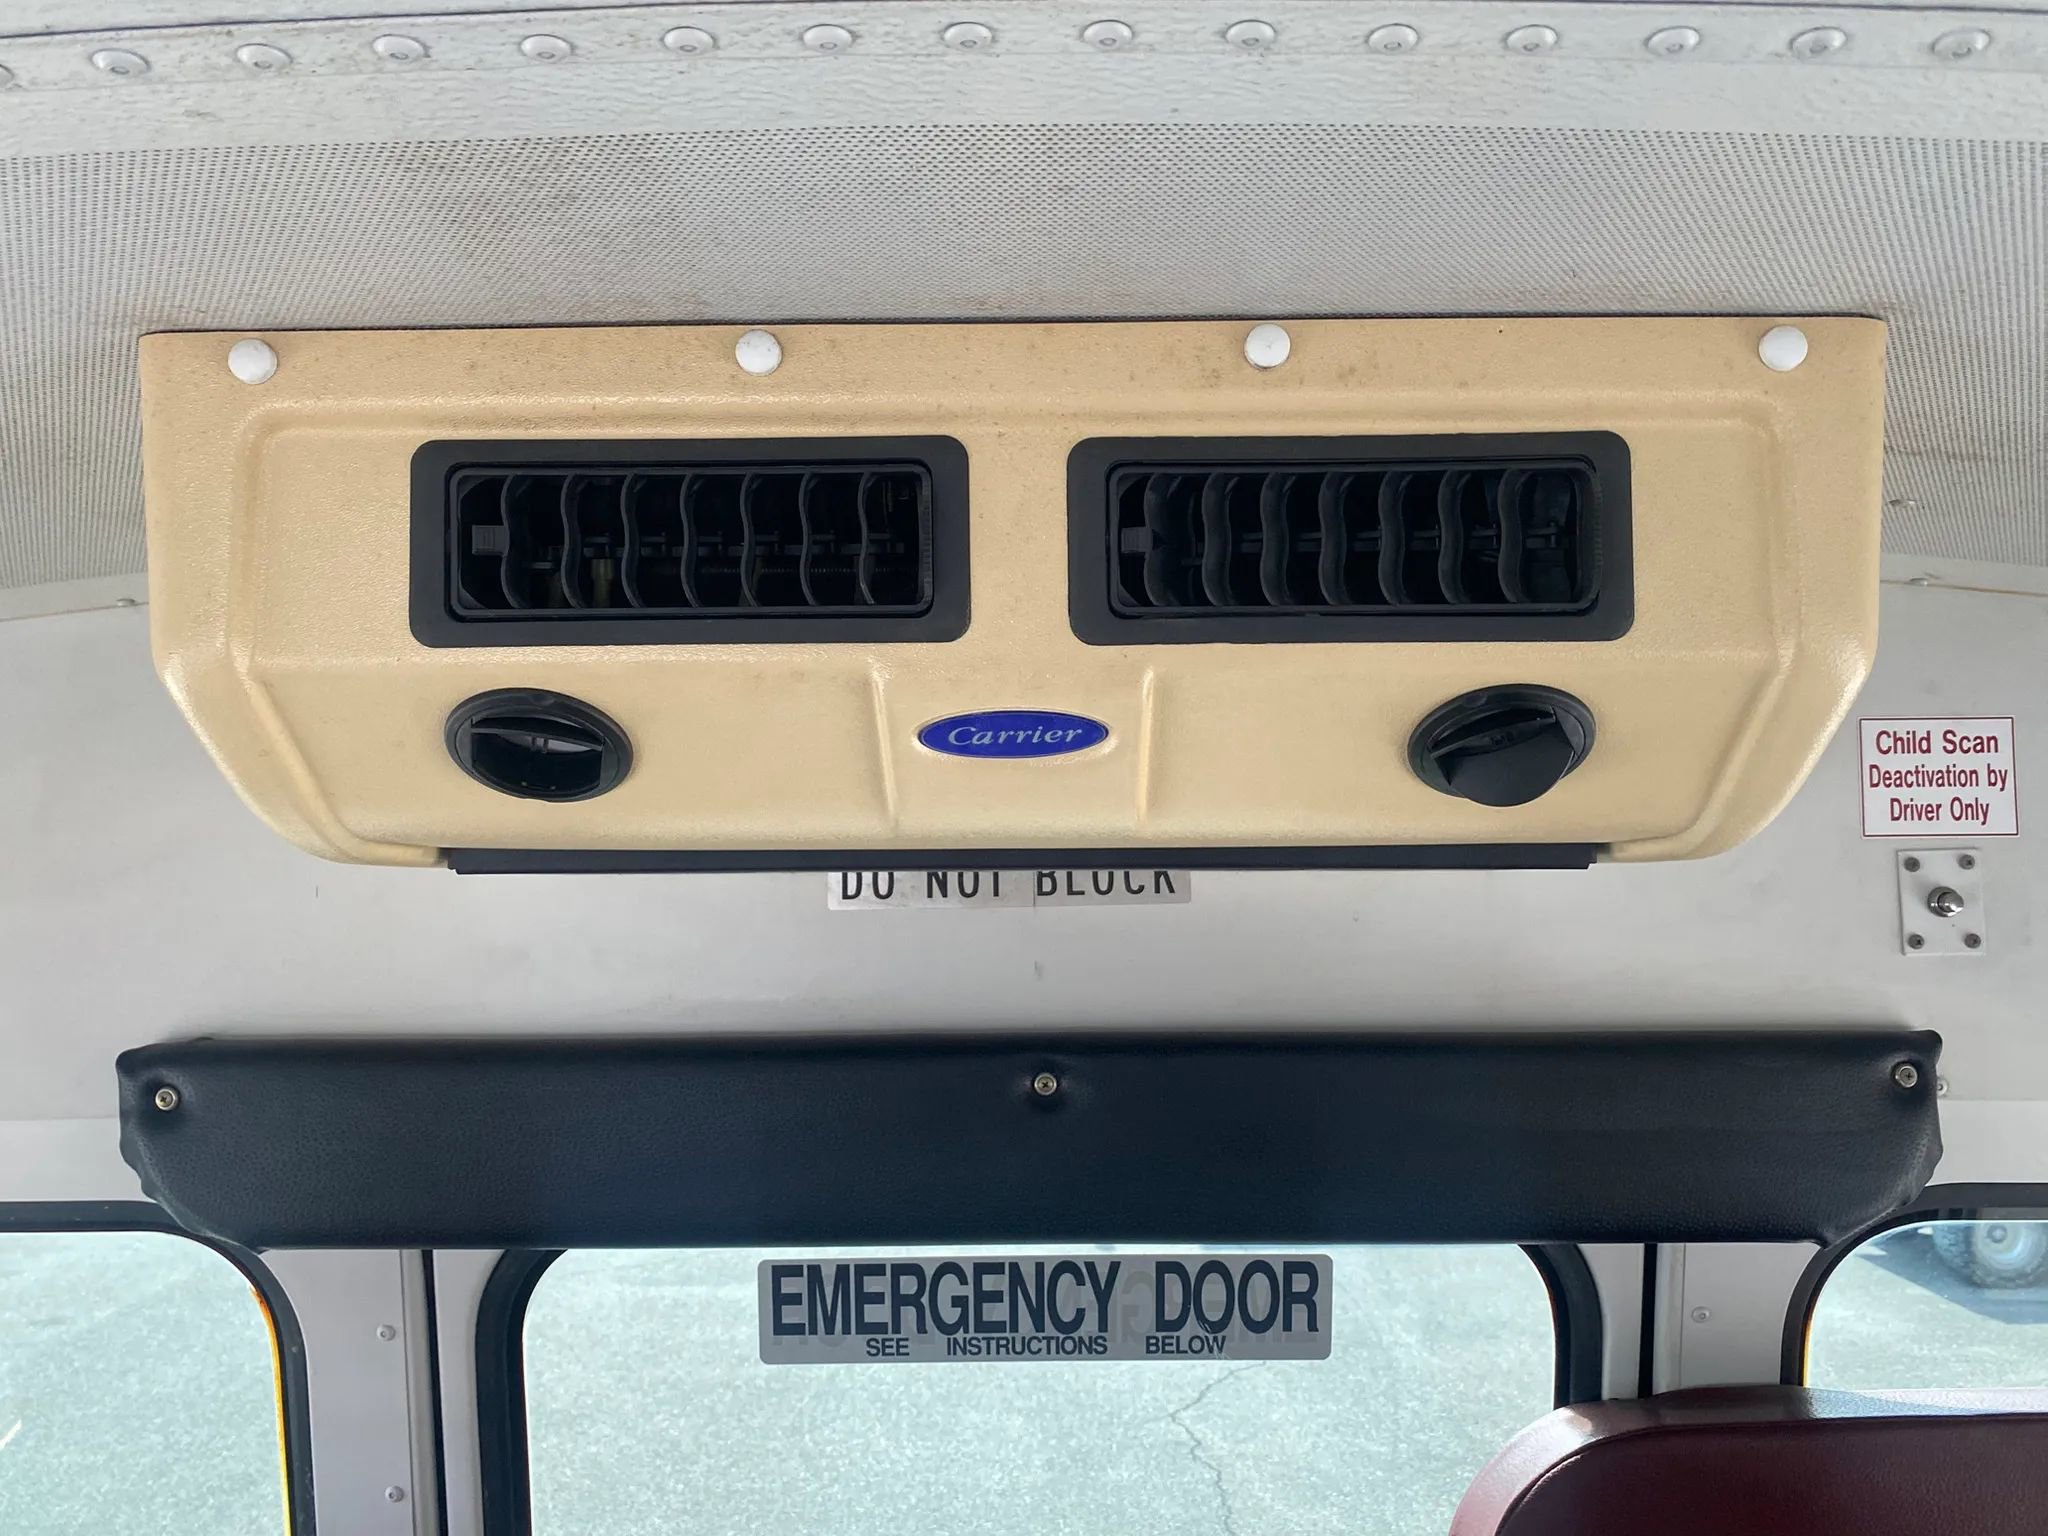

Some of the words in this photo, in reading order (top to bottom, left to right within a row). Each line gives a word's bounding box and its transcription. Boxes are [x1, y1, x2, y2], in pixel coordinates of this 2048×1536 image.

[948, 726, 1082, 746] Carrier
[1875, 730, 1931, 755] Child
[1942, 729, 1999, 754] Scan
[1869, 763, 1979, 788] Deactivation
[1987, 763, 2008, 792] by
[1890, 797, 1942, 822] Driver
[1950, 796, 1990, 826] Only
[841, 871, 895, 900] DO
[1036, 870, 1176, 896] BLOCK
[770, 1260, 1122, 1337] EMERGENCY
[1154, 1260, 1320, 1334] DOOR
[866, 1337, 910, 1357] SEE
[946, 1335, 1108, 1356] INSTRUCTIONS
[1145, 1335, 1226, 1355] BELOW
